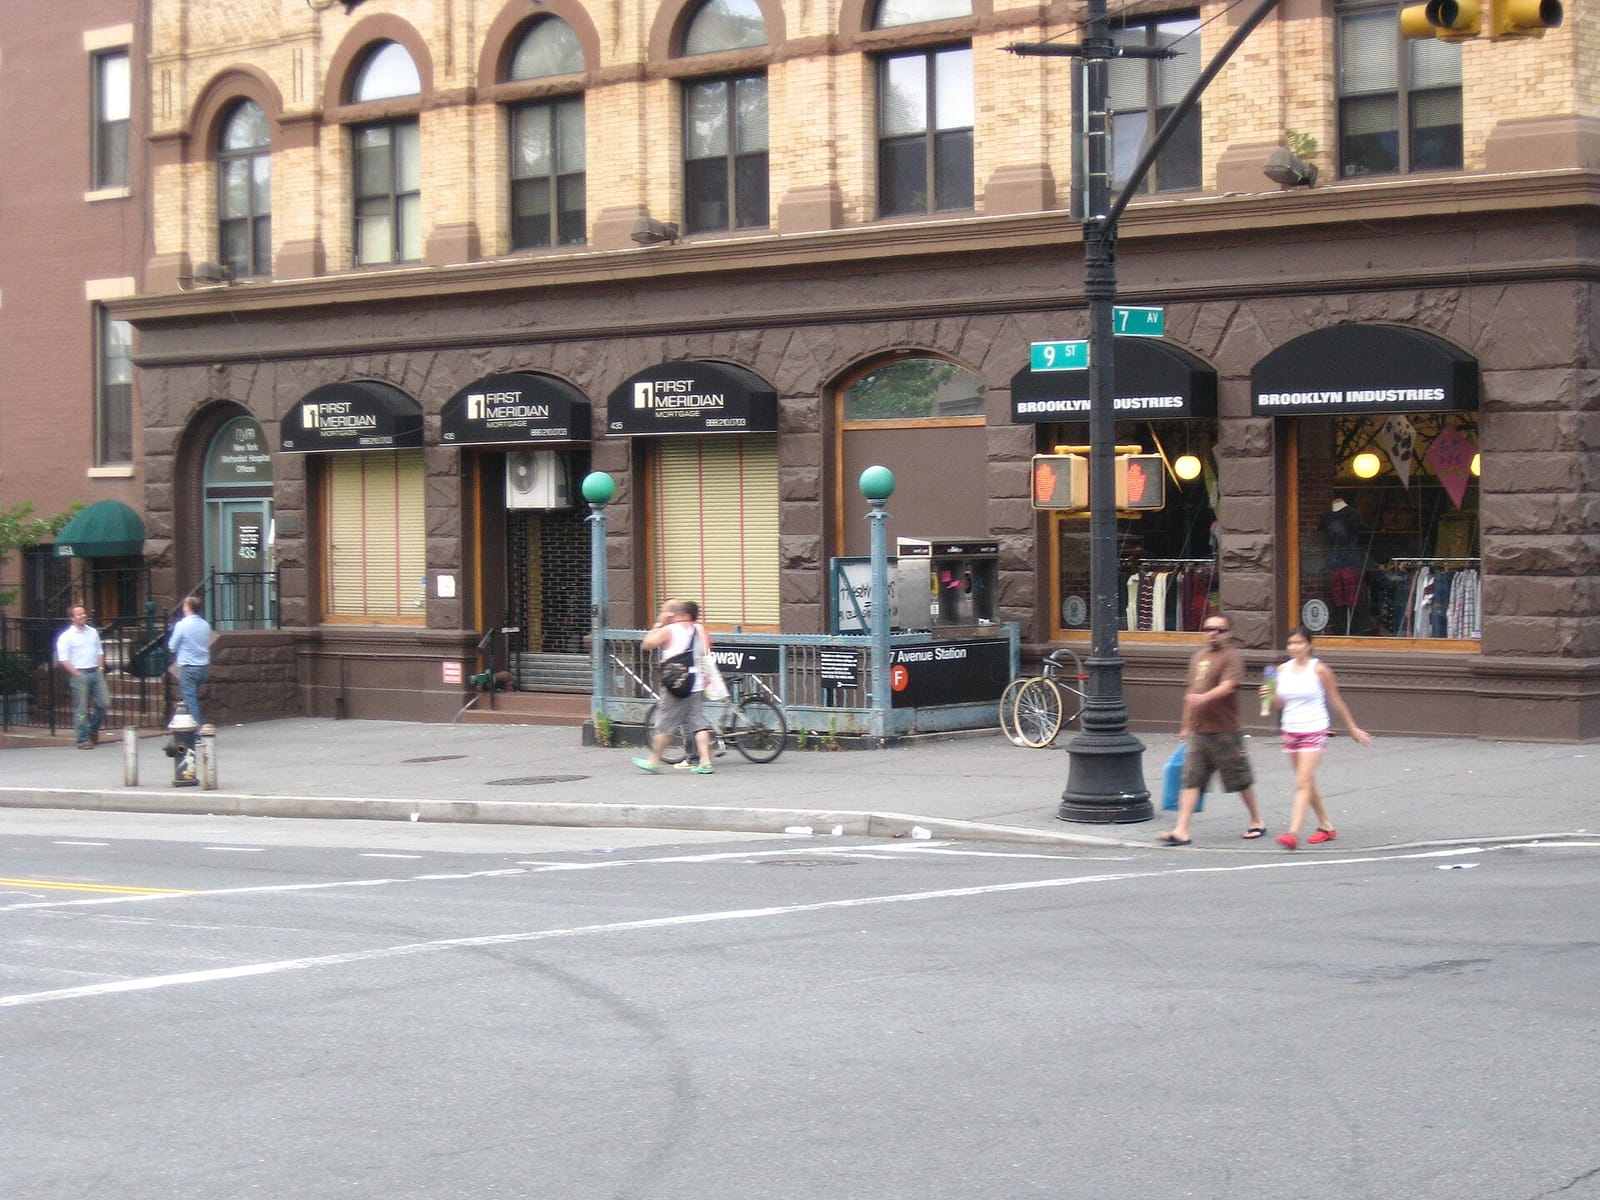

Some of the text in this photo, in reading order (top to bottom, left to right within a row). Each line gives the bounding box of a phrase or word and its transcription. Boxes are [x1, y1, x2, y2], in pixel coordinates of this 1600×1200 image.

[1119, 310, 1158, 331] 7 AV
[1044, 346, 1076, 367] 9 ST
[655, 380, 694, 393] FIRST
[486, 391, 522, 404] FIRST
[655, 394, 724, 408] MERIDIAN
[1258, 388, 1445, 406] BROOKLYN INDUSTRIES
[320, 402, 352, 414] FIRST
[1017, 396, 1184, 413] BROOKLYN DUSTRIES
[486, 405, 549, 418] MERIDIAN
[655, 410, 700, 418] MORTGAGE
[320, 415, 376, 427] MERIDIAN
[486, 420, 527, 429] MORTGAGE
[610, 421, 623, 430] 435
[320, 429, 357, 437] MORTGAGE
[443, 432, 455, 440] 435
[283, 440, 294, 448] 435
[239, 546, 256, 559] 435
[890, 647, 967, 663] 7 Avenue Station
[895, 671, 903, 685] F
